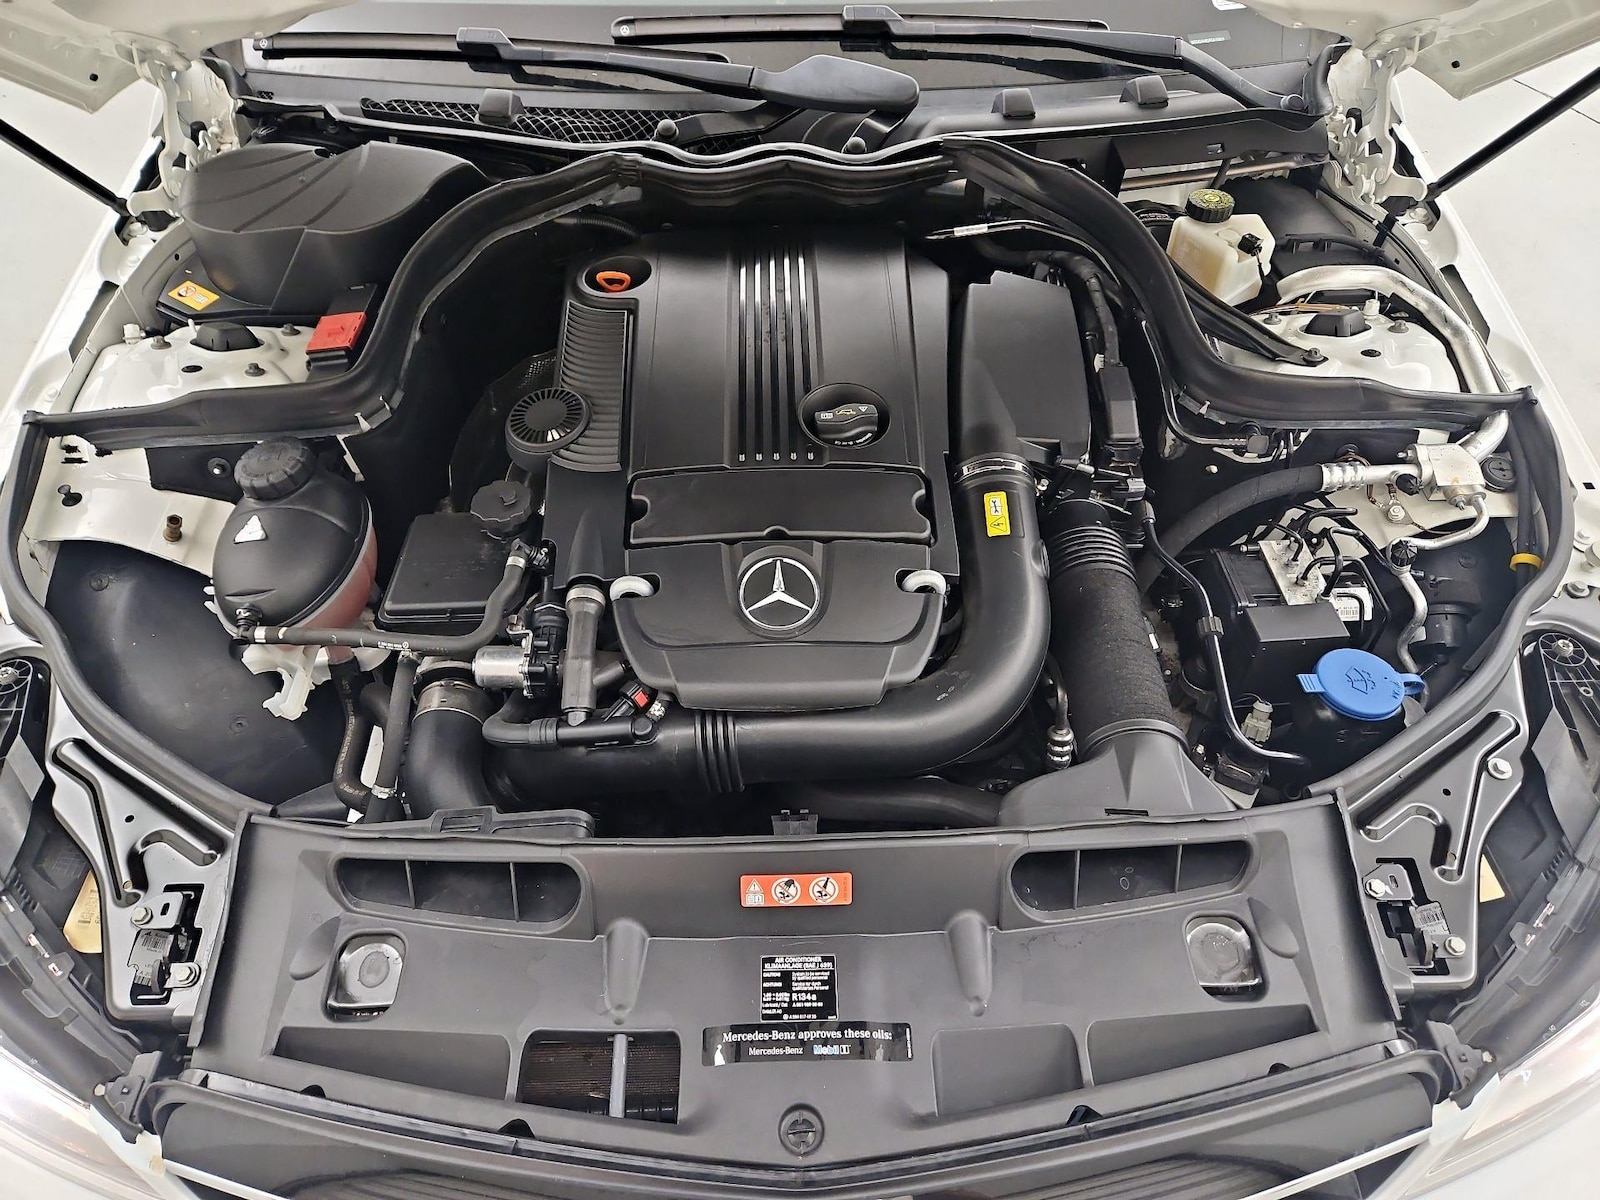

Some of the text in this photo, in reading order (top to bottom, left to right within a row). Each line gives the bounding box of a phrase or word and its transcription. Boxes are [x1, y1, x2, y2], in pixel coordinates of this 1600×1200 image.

[723, 1028, 892, 1042] Mercedes-Benz approves these oils:
[749, 1046, 803, 1055] Mercedes-Benz
[813, 1044, 839, 1055] Mobil
